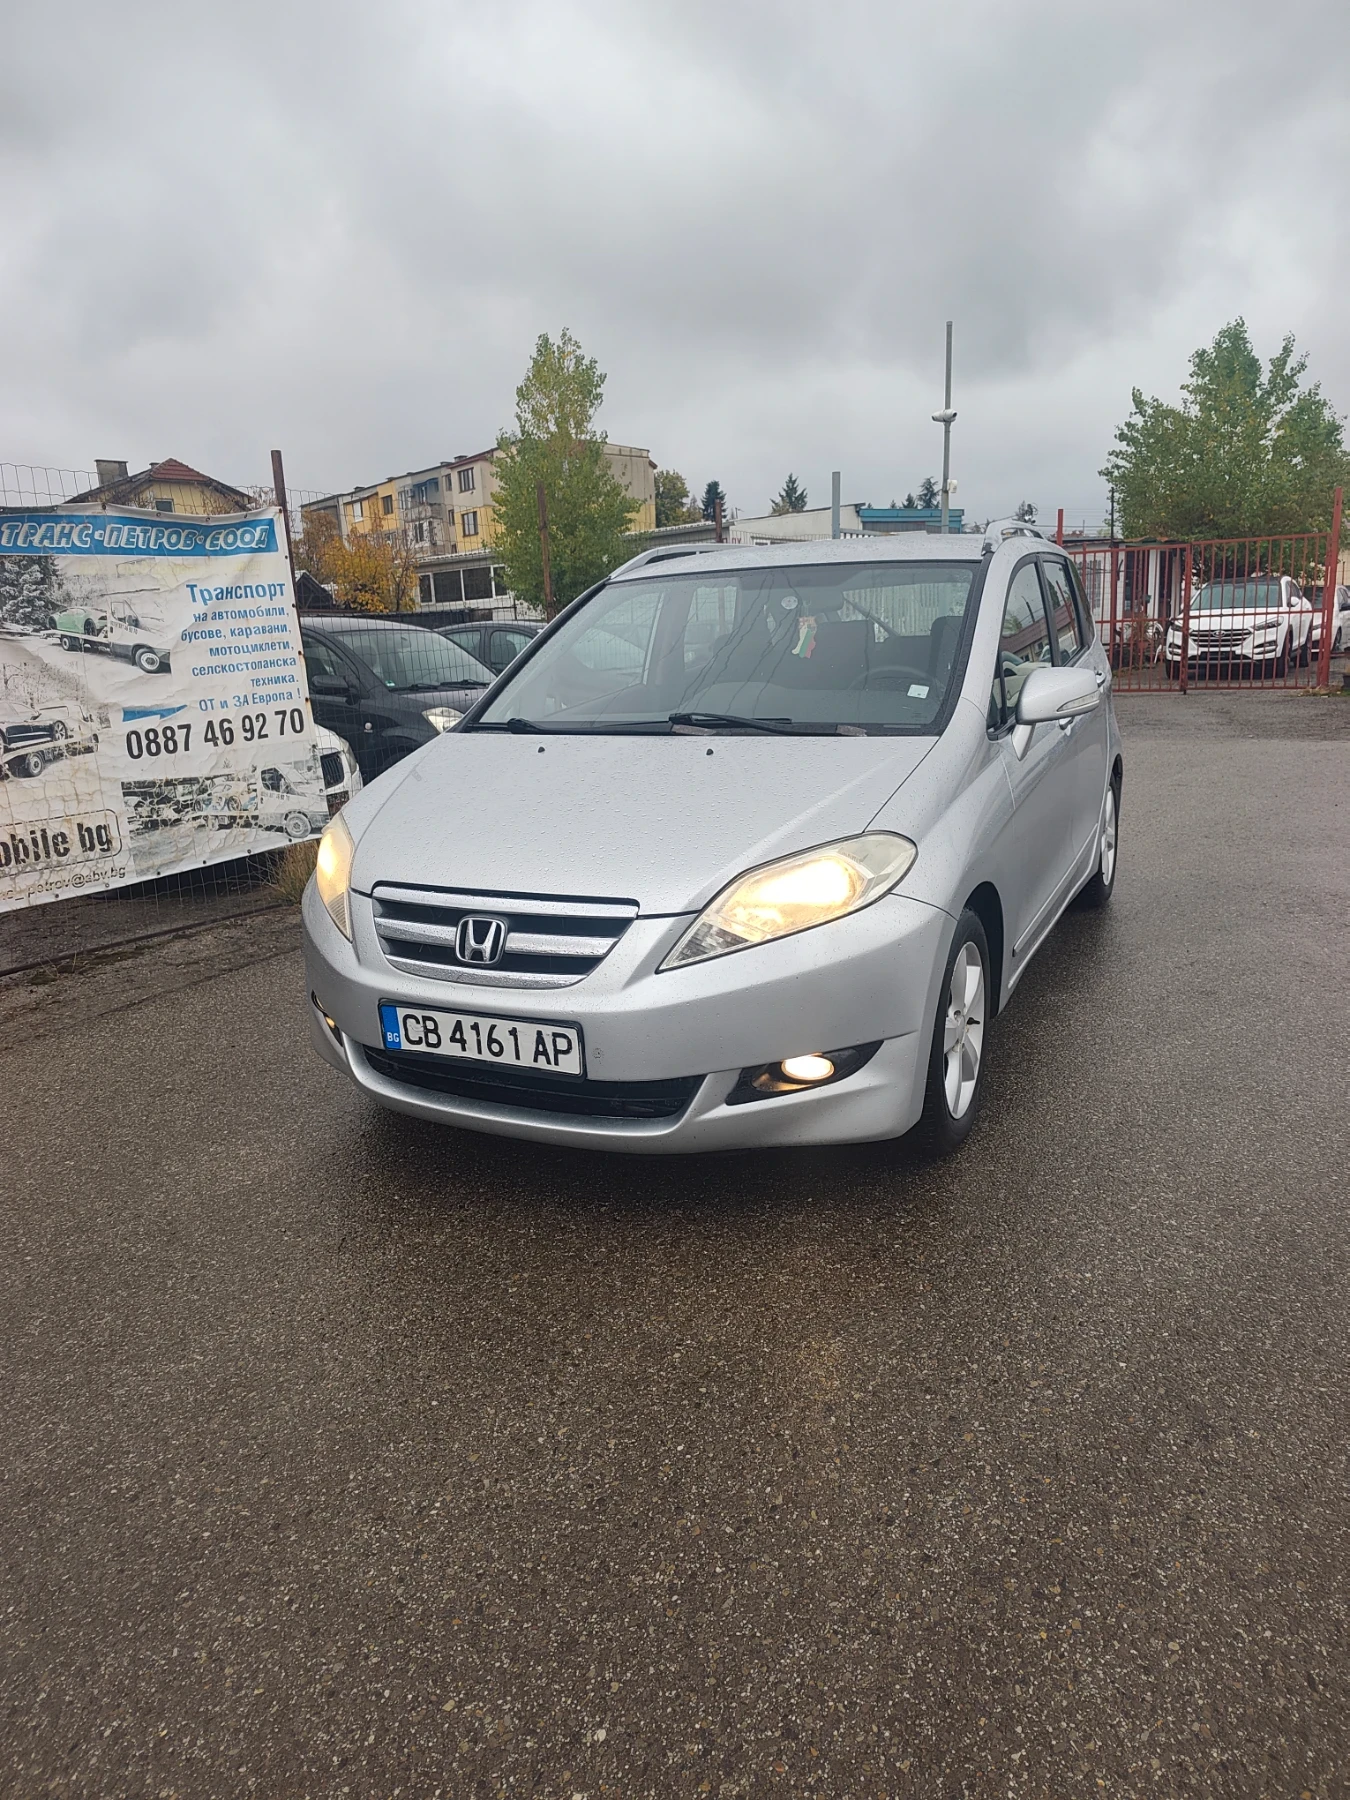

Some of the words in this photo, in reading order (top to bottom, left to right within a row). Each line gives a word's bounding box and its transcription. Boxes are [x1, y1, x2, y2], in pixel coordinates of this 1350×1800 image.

[1, 521, 92, 548] ТРАНС
[103, 524, 197, 550] ПЕТРОВ
[186, 583, 285, 606] Транспорт
[193, 612, 208, 622] на
[211, 605, 289, 621] автомобили,
[181, 629, 226, 643] бусове,
[230, 623, 292, 639] каравани,
[209, 640, 294, 657] мотоциклети,
[192, 657, 296, 677] селскостопанска
[250, 674, 299, 688] техника.
[199, 698, 215, 711] ОТ
[220, 699, 229, 709] и
[232, 694, 249, 708] ЗА
[252, 691, 293, 705] Европа
[126, 723, 192, 760] 0887
[203, 718, 235, 748] 46
[241, 712, 269, 742] 92
[274, 708, 305, 736] 70
[387, 1032, 399, 1043] BG
[402, 1013, 442, 1048] CB
[449, 1019, 521, 1061] 4161
[532, 1030, 573, 1067] AP
